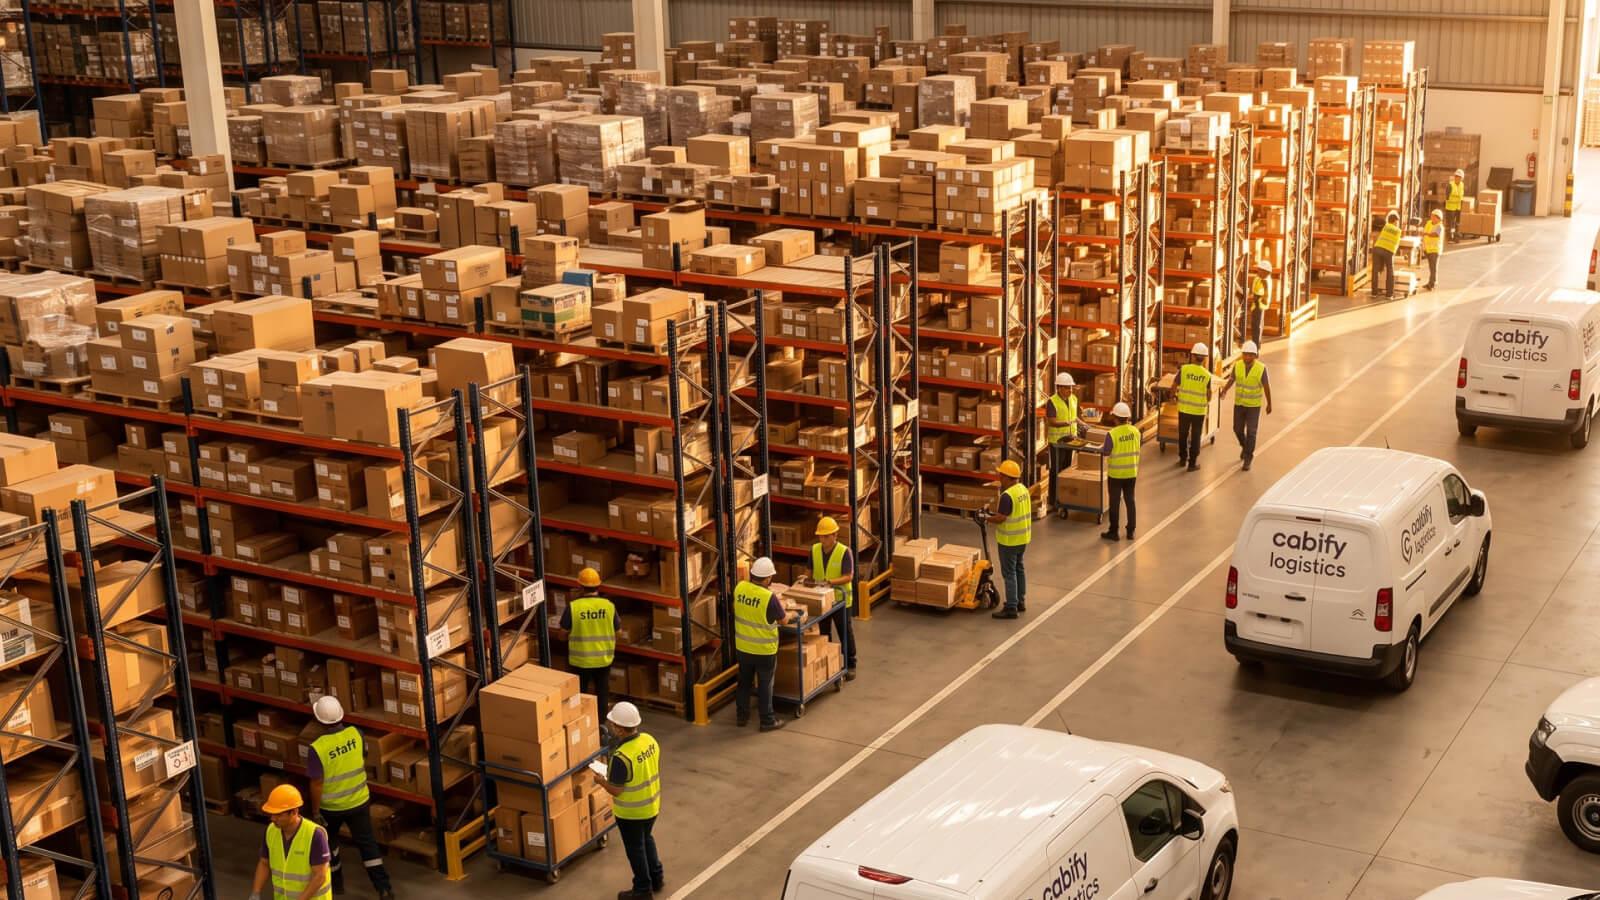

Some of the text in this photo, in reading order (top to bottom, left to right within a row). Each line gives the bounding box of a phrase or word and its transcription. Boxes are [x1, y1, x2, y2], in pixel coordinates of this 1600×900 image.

[1492, 329, 1549, 349] cabify
[1489, 345, 1548, 362] logistics
[1186, 373, 1206, 382] staff
[1272, 530, 1347, 560] cabify
[1269, 552, 1346, 578] logistics
[737, 594, 761, 608] staff
[580, 608, 606, 620] staff
[328, 738, 357, 760] staff
[636, 744, 656, 763] staff
[1042, 852, 1088, 900] cabify
